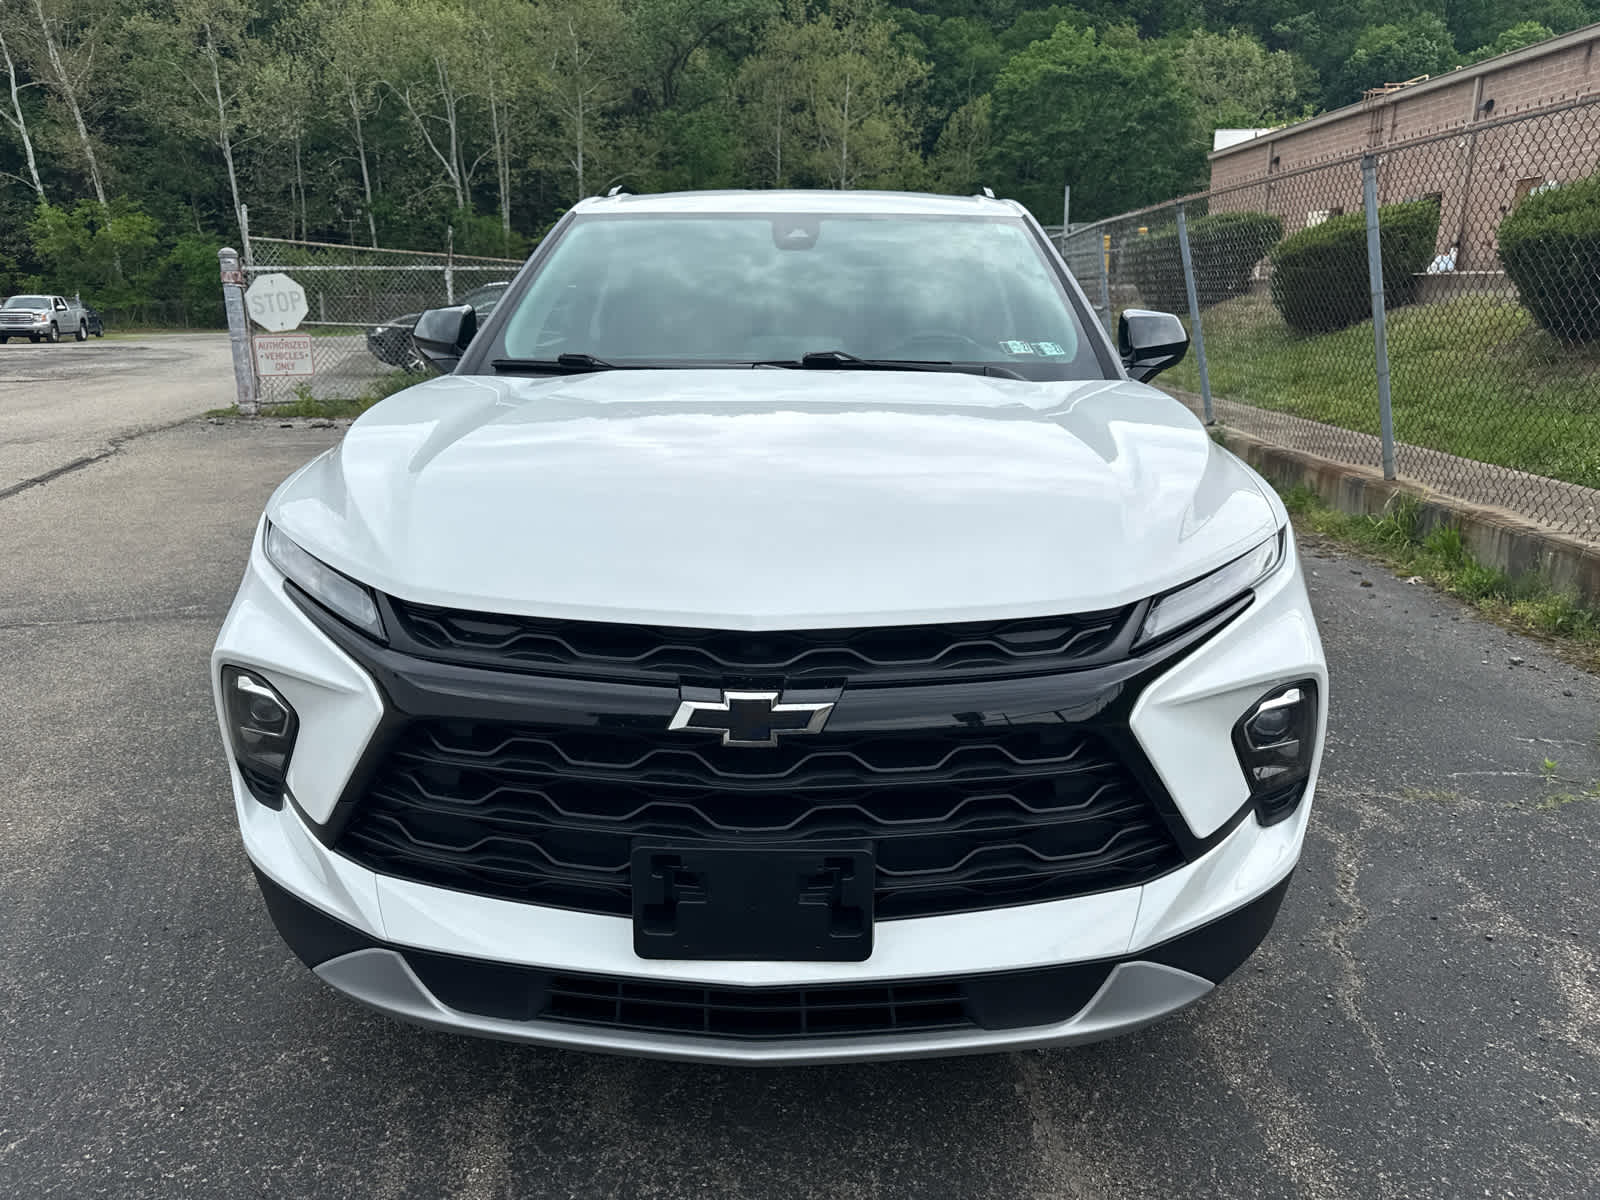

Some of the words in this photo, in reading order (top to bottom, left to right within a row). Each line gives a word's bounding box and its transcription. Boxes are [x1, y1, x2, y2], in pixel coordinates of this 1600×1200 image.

[252, 291, 301, 314] STOP
[258, 341, 308, 350] AUTHORIZED
[265, 352, 305, 360] VEHICLES
[275, 362, 295, 370] ONLY
